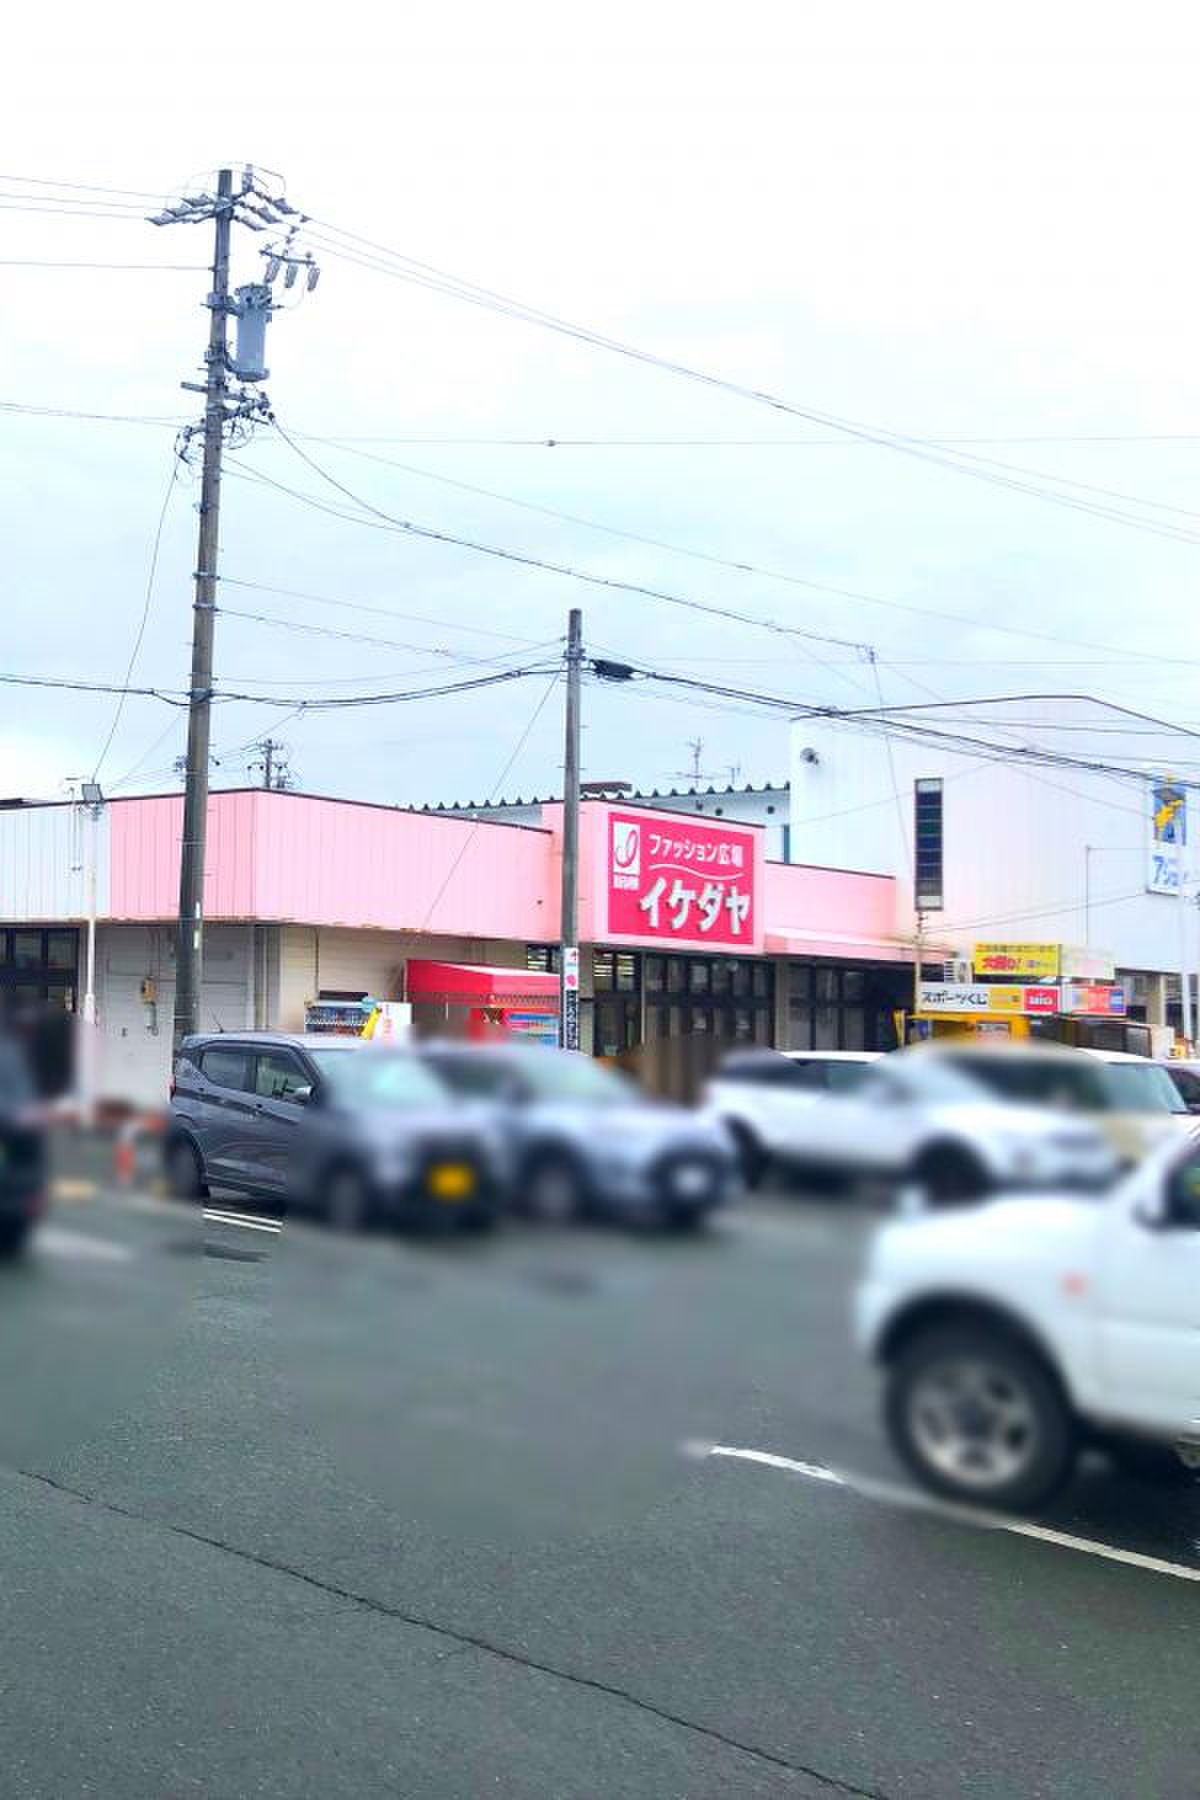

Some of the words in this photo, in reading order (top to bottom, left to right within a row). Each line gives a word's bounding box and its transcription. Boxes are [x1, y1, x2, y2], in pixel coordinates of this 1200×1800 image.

[649, 834, 744, 867] ファッション広場
[640, 877, 751, 935] イケダヤ
[920, 989, 988, 1006] スポーツくじ
